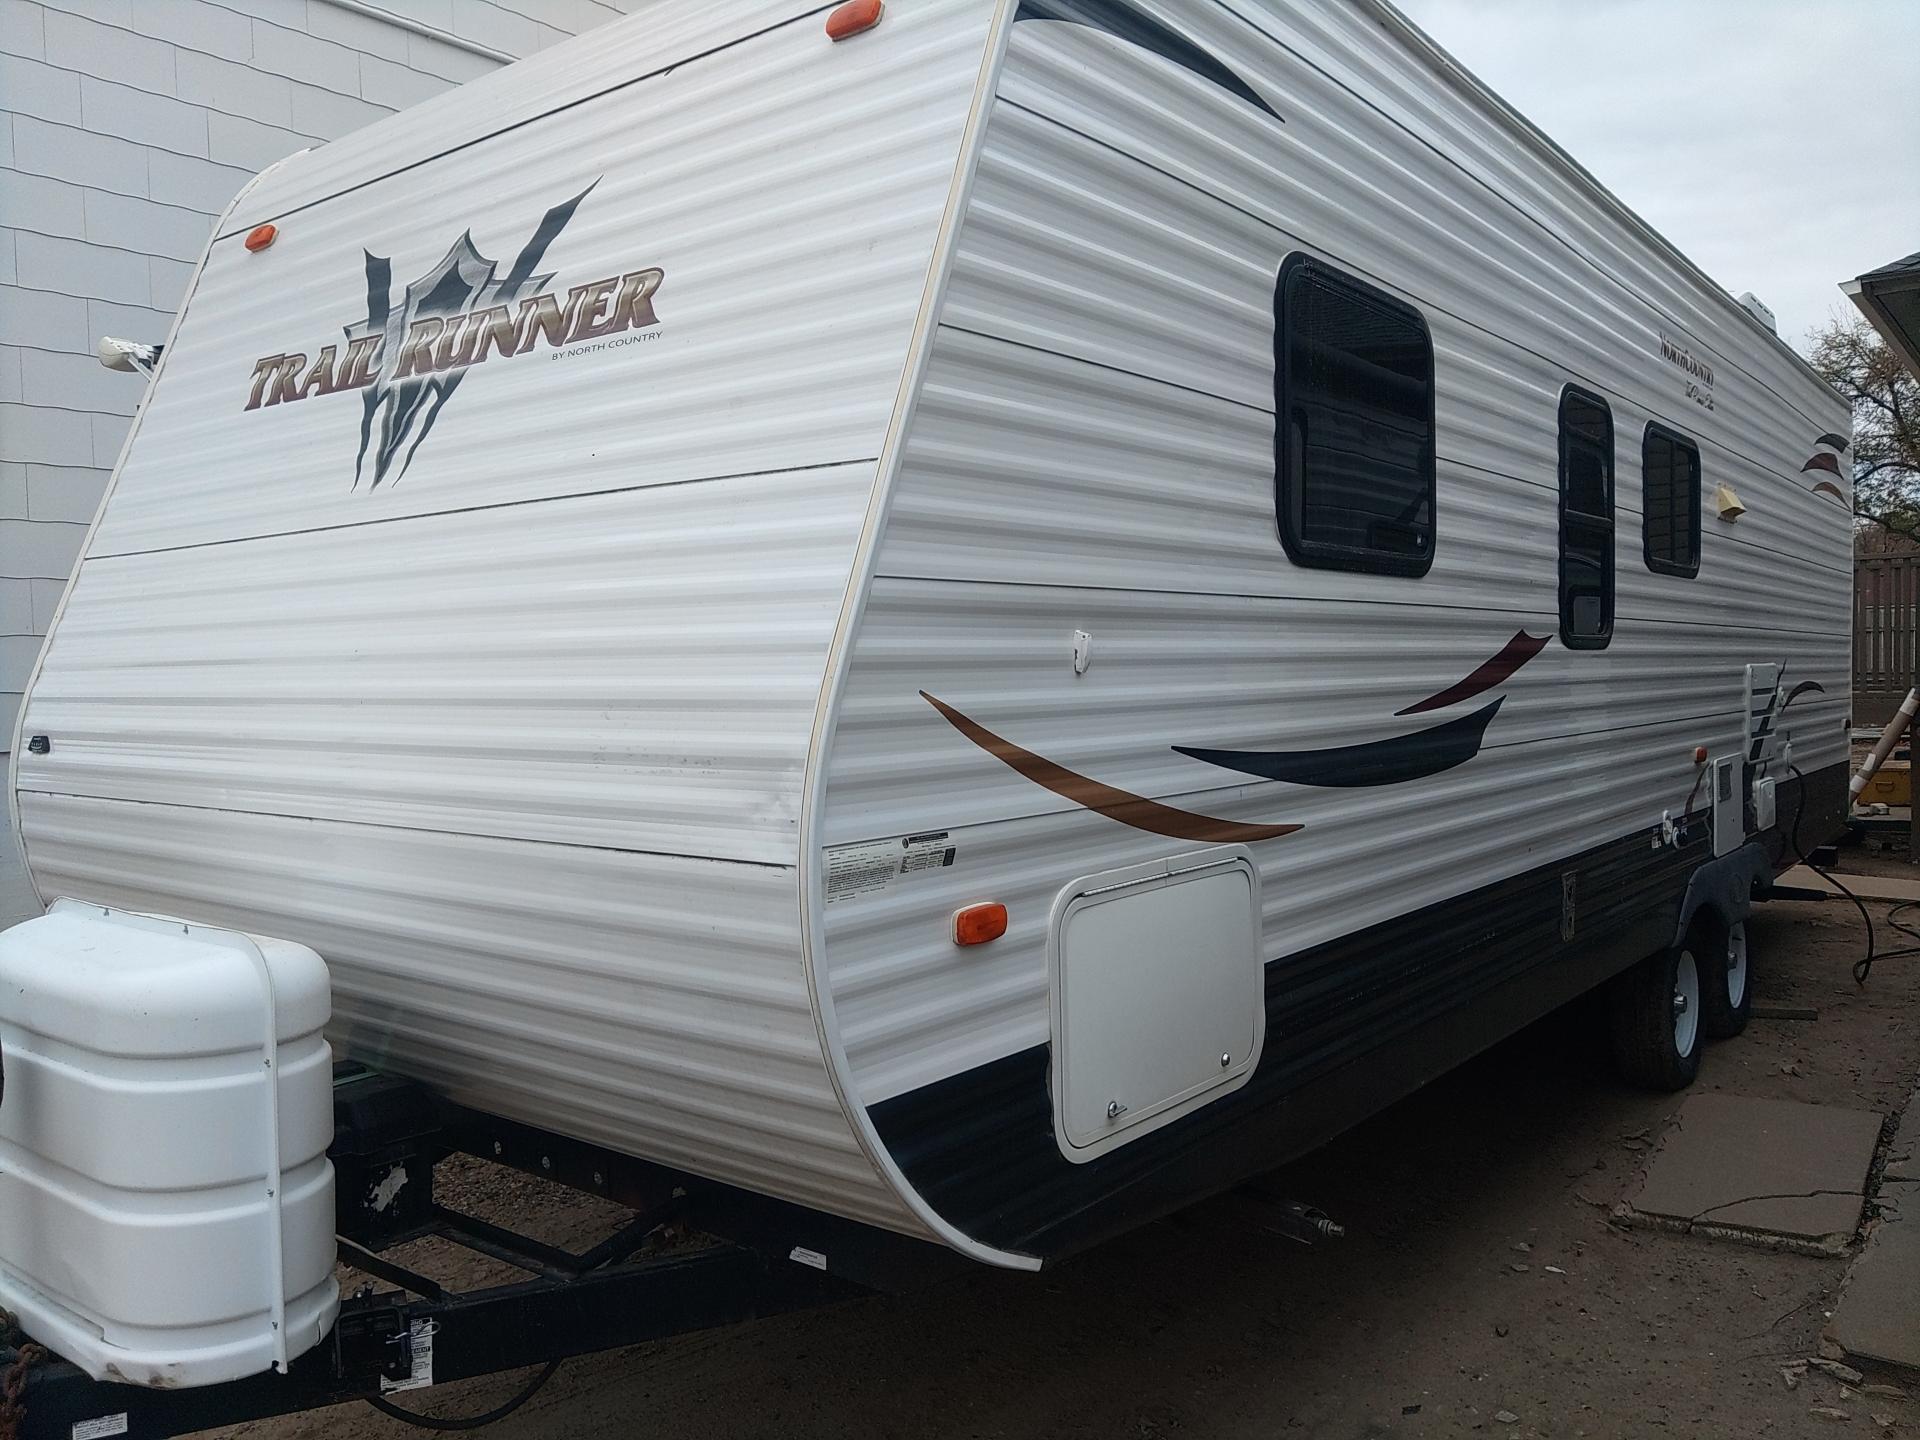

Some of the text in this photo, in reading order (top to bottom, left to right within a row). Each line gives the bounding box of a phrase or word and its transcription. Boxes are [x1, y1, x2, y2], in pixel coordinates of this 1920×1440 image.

[244, 267, 665, 411] TRAIL RUNNER
[552, 331, 664, 361] BY NORTH COUNTRY
